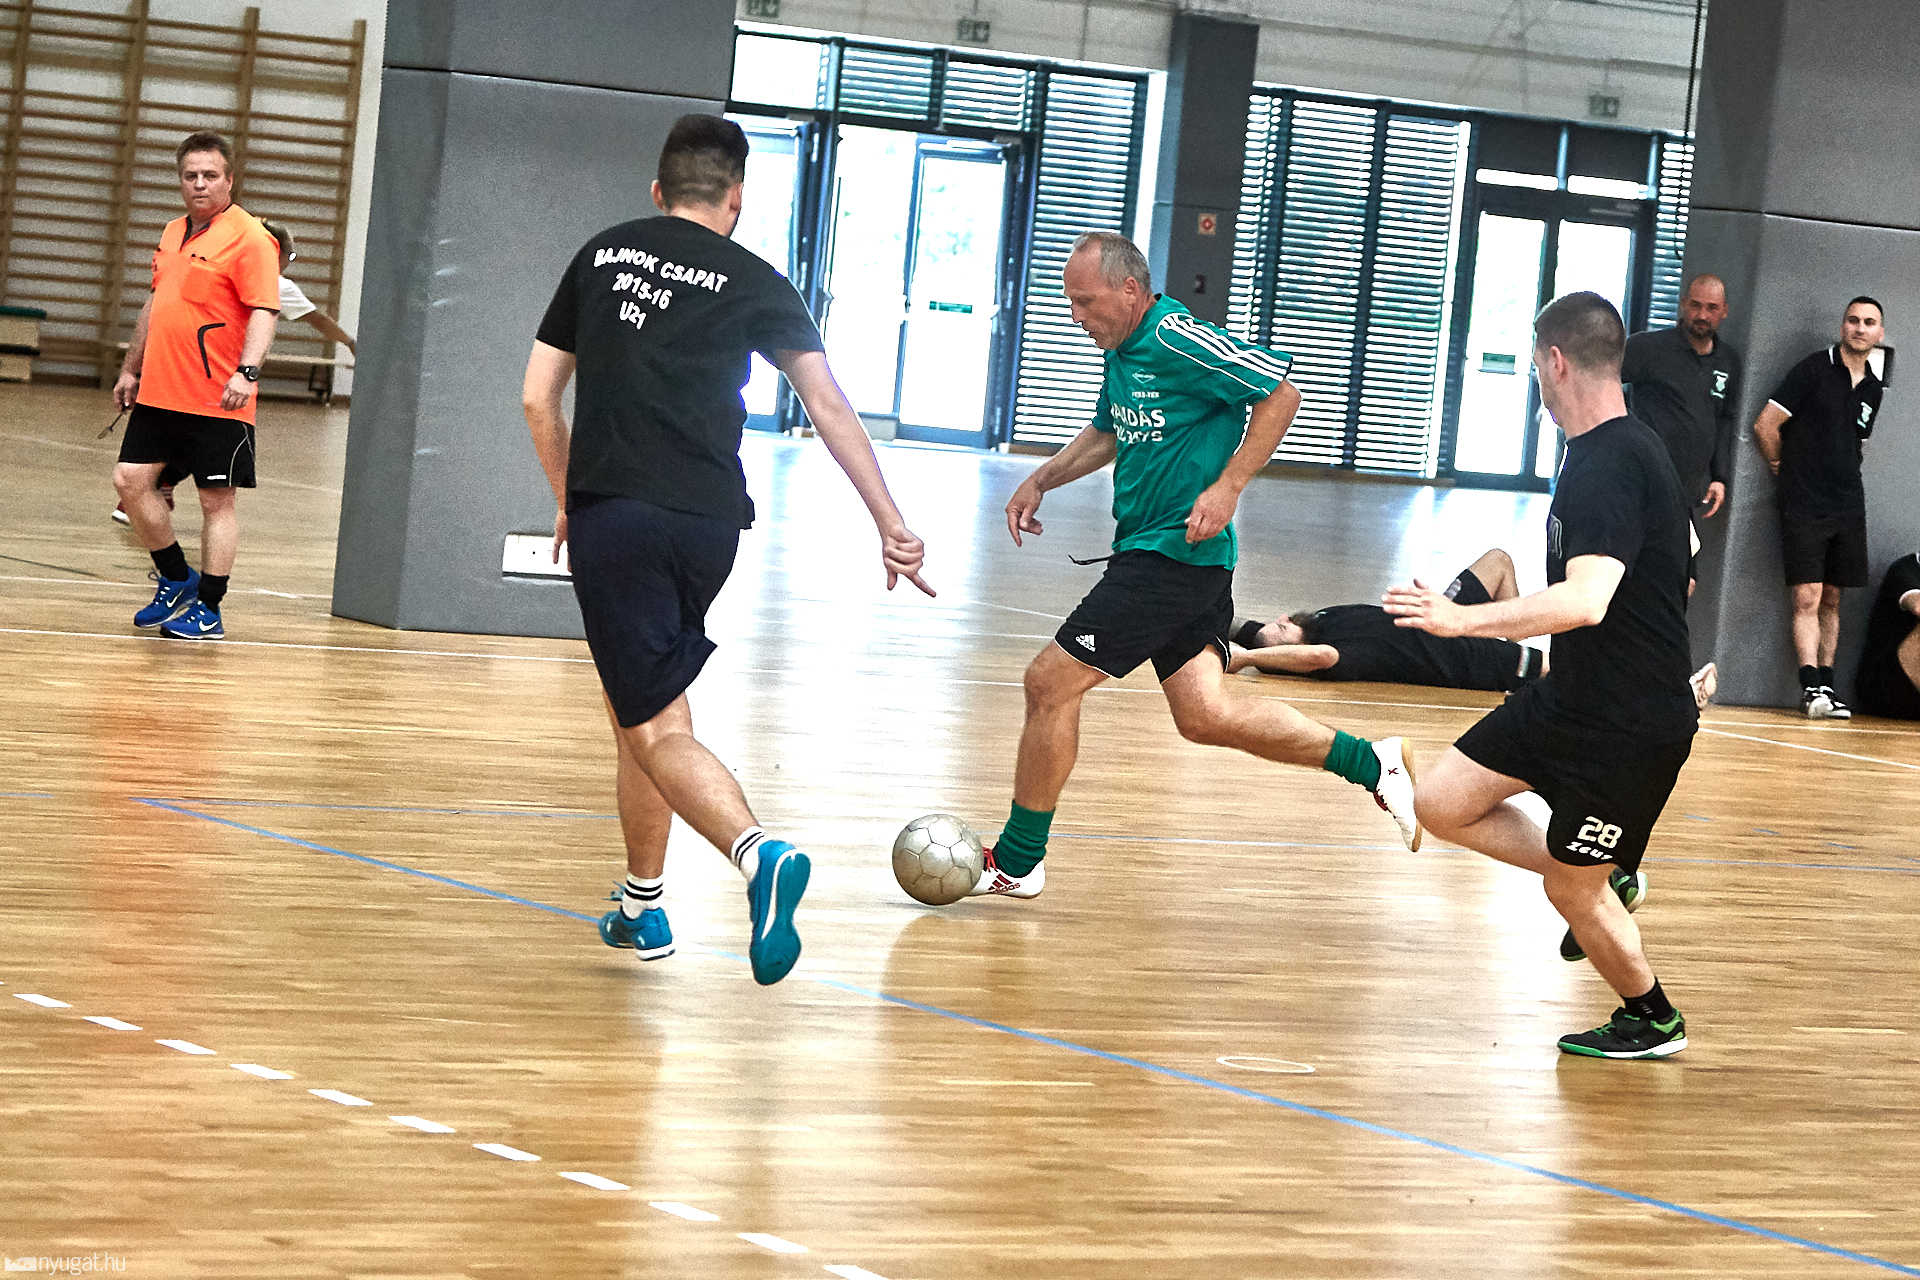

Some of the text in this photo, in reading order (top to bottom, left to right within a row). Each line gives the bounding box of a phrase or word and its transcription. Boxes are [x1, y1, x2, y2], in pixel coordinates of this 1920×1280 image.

[593, 247, 729, 293] BAJNOK CSAPAT
[612, 272, 673, 310] 2015-16
[619, 300, 647, 330] U21
[1577, 815, 1623, 849] 28
